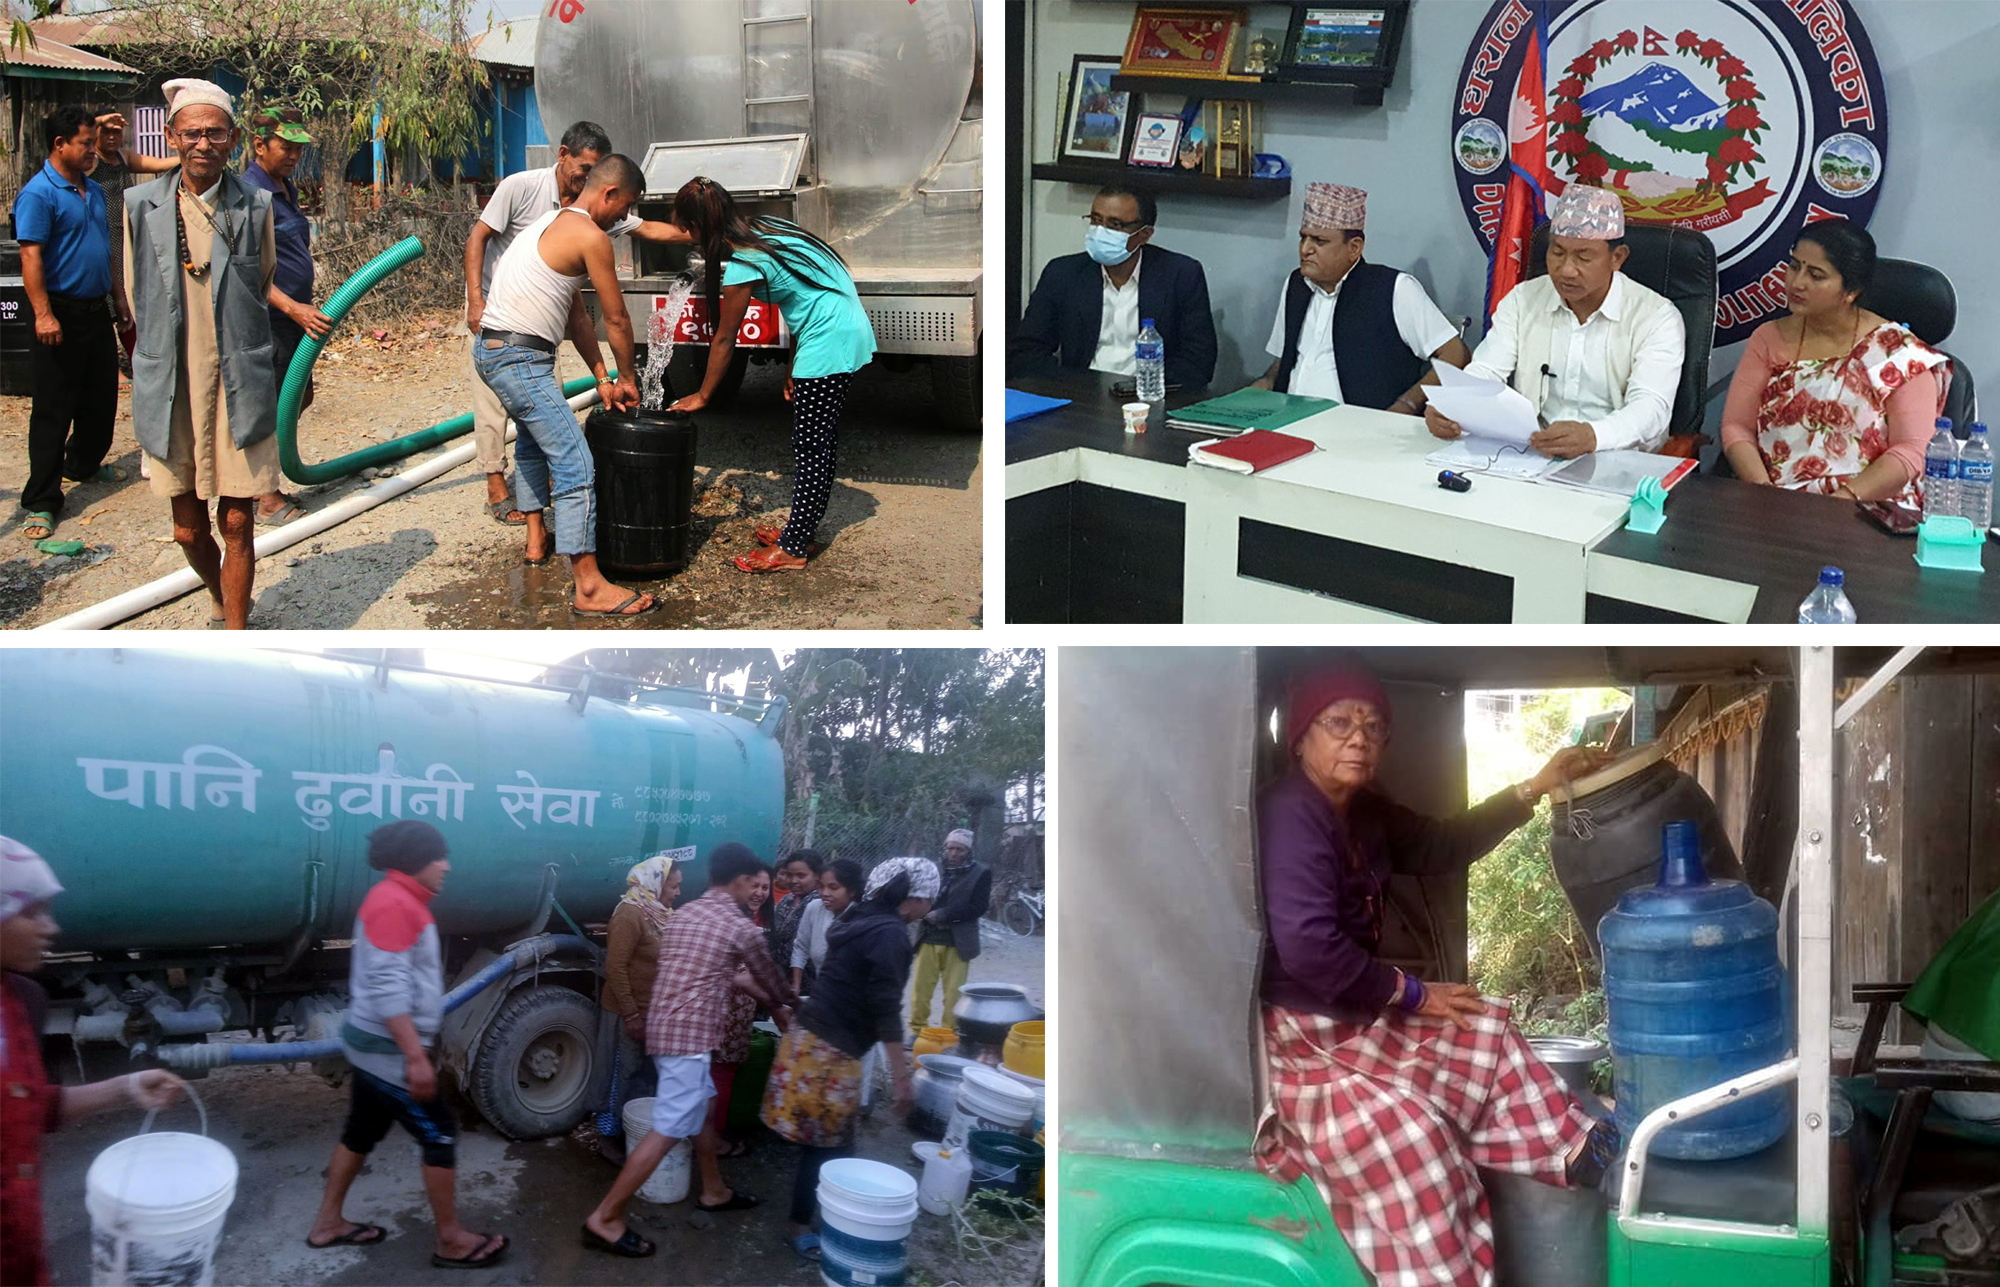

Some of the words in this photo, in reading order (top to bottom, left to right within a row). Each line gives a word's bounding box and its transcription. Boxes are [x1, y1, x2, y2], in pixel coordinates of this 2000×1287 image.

[1782, 0, 1876, 131] लिका
[0, 301, 19, 311] 300
[76, 744, 262, 814] पानि
[291, 762, 474, 832] ढुवानी
[496, 769, 601, 831] सेवा
